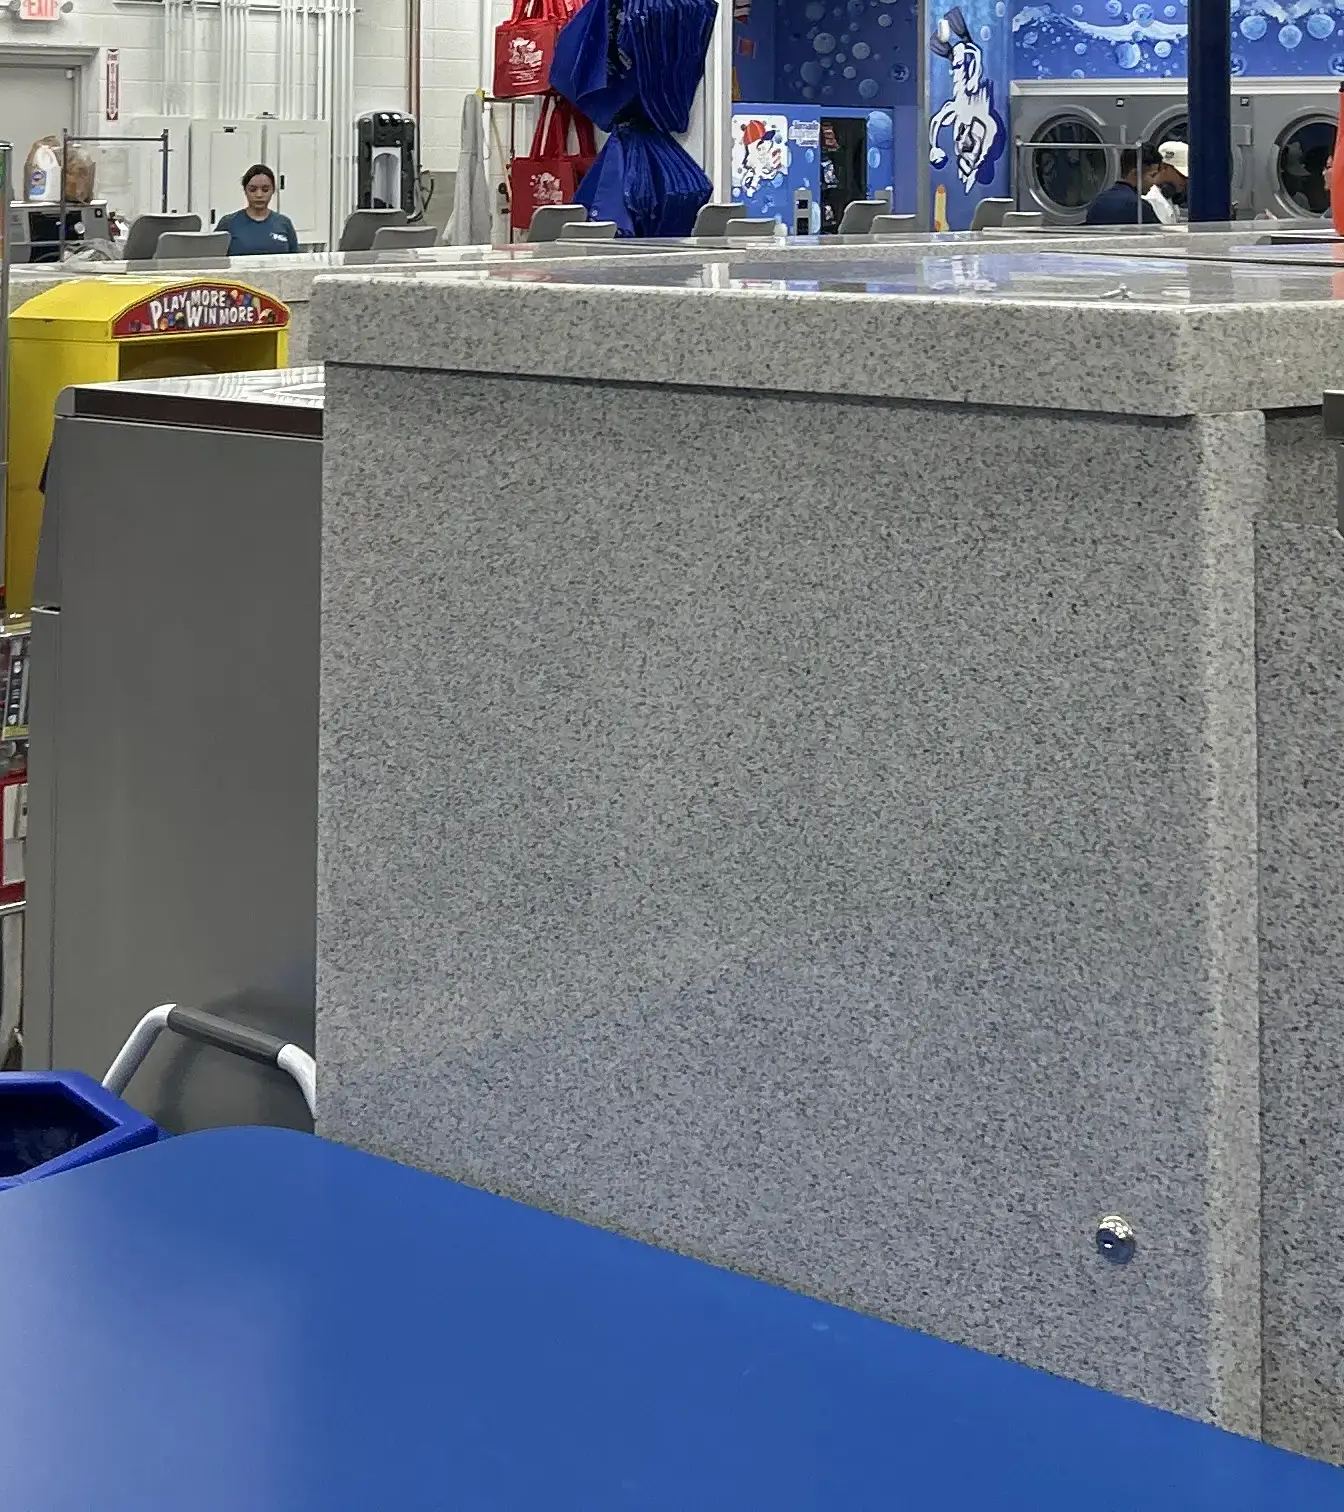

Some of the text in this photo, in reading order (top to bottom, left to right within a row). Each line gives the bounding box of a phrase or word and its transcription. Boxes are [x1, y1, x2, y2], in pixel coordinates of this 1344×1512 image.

[149, 289, 227, 330] PLAY MORE
[186, 301, 217, 328] WIN
